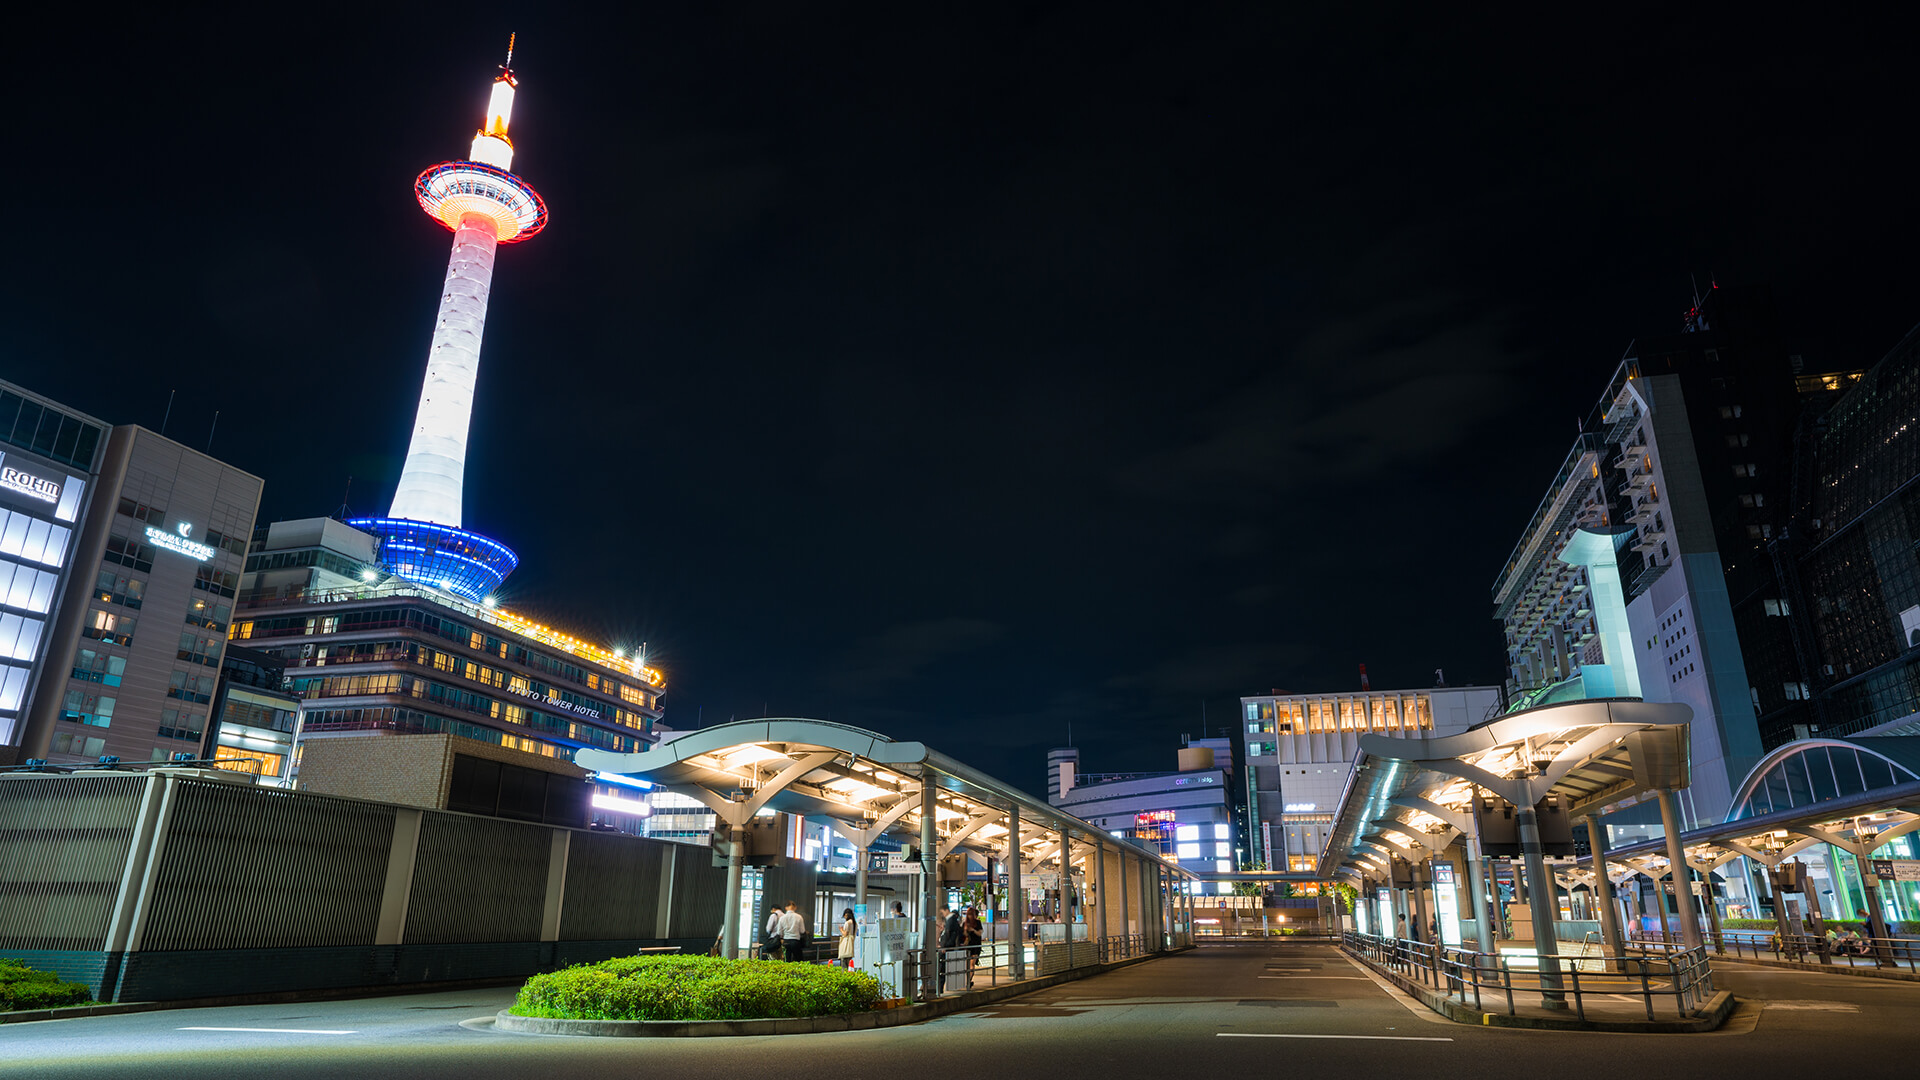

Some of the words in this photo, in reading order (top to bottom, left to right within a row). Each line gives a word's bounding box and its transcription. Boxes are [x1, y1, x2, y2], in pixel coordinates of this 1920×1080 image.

[3, 467, 61, 497] ROHM
[506, 685, 540, 700] KYOTO
[541, 694, 573, 710] TOWER
[573, 704, 600, 719] HOTEL
[1438, 872, 1450, 880] A1
